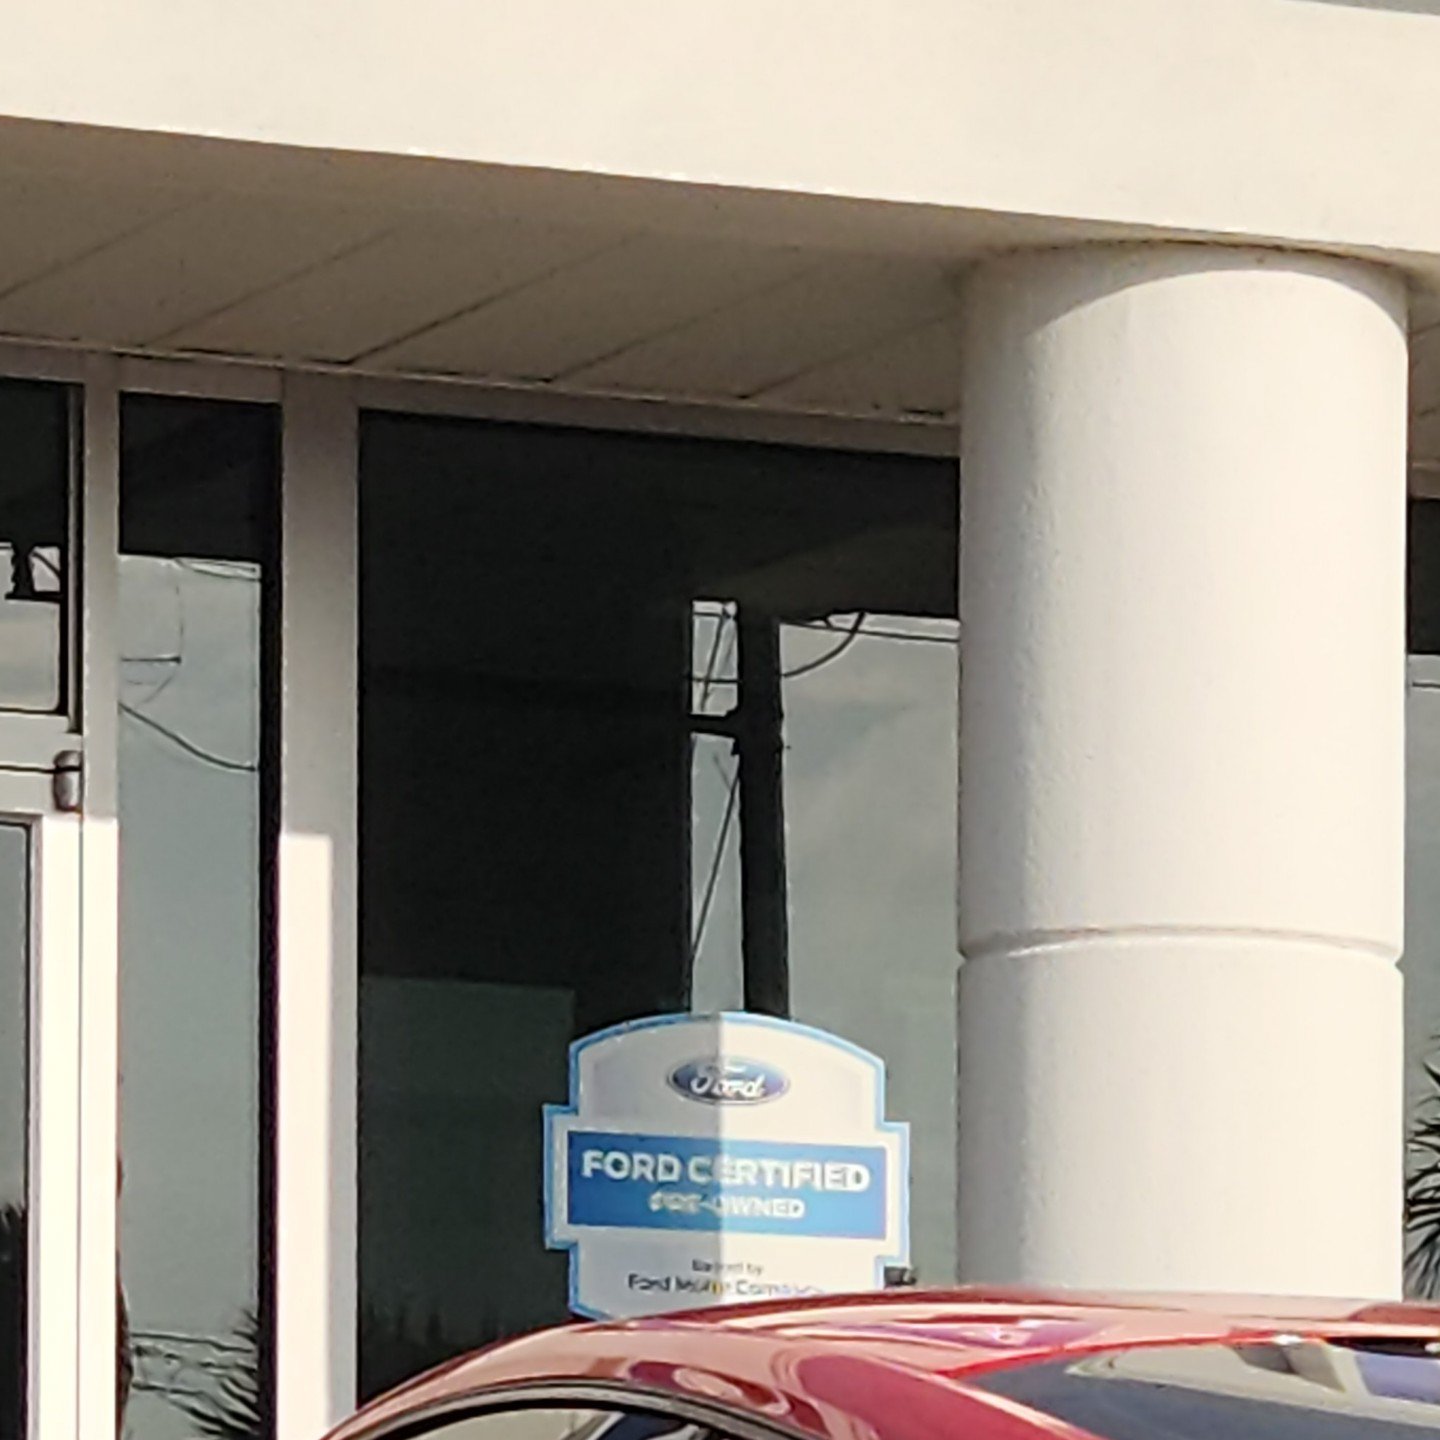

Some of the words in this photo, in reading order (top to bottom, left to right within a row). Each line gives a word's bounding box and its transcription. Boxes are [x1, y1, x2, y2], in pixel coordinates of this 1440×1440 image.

[690, 1062, 766, 1098] Ford
[581, 1149, 681, 1182] FORD
[688, 1154, 871, 1191] CERTIFIED
[628, 1273, 670, 1291] Ford
